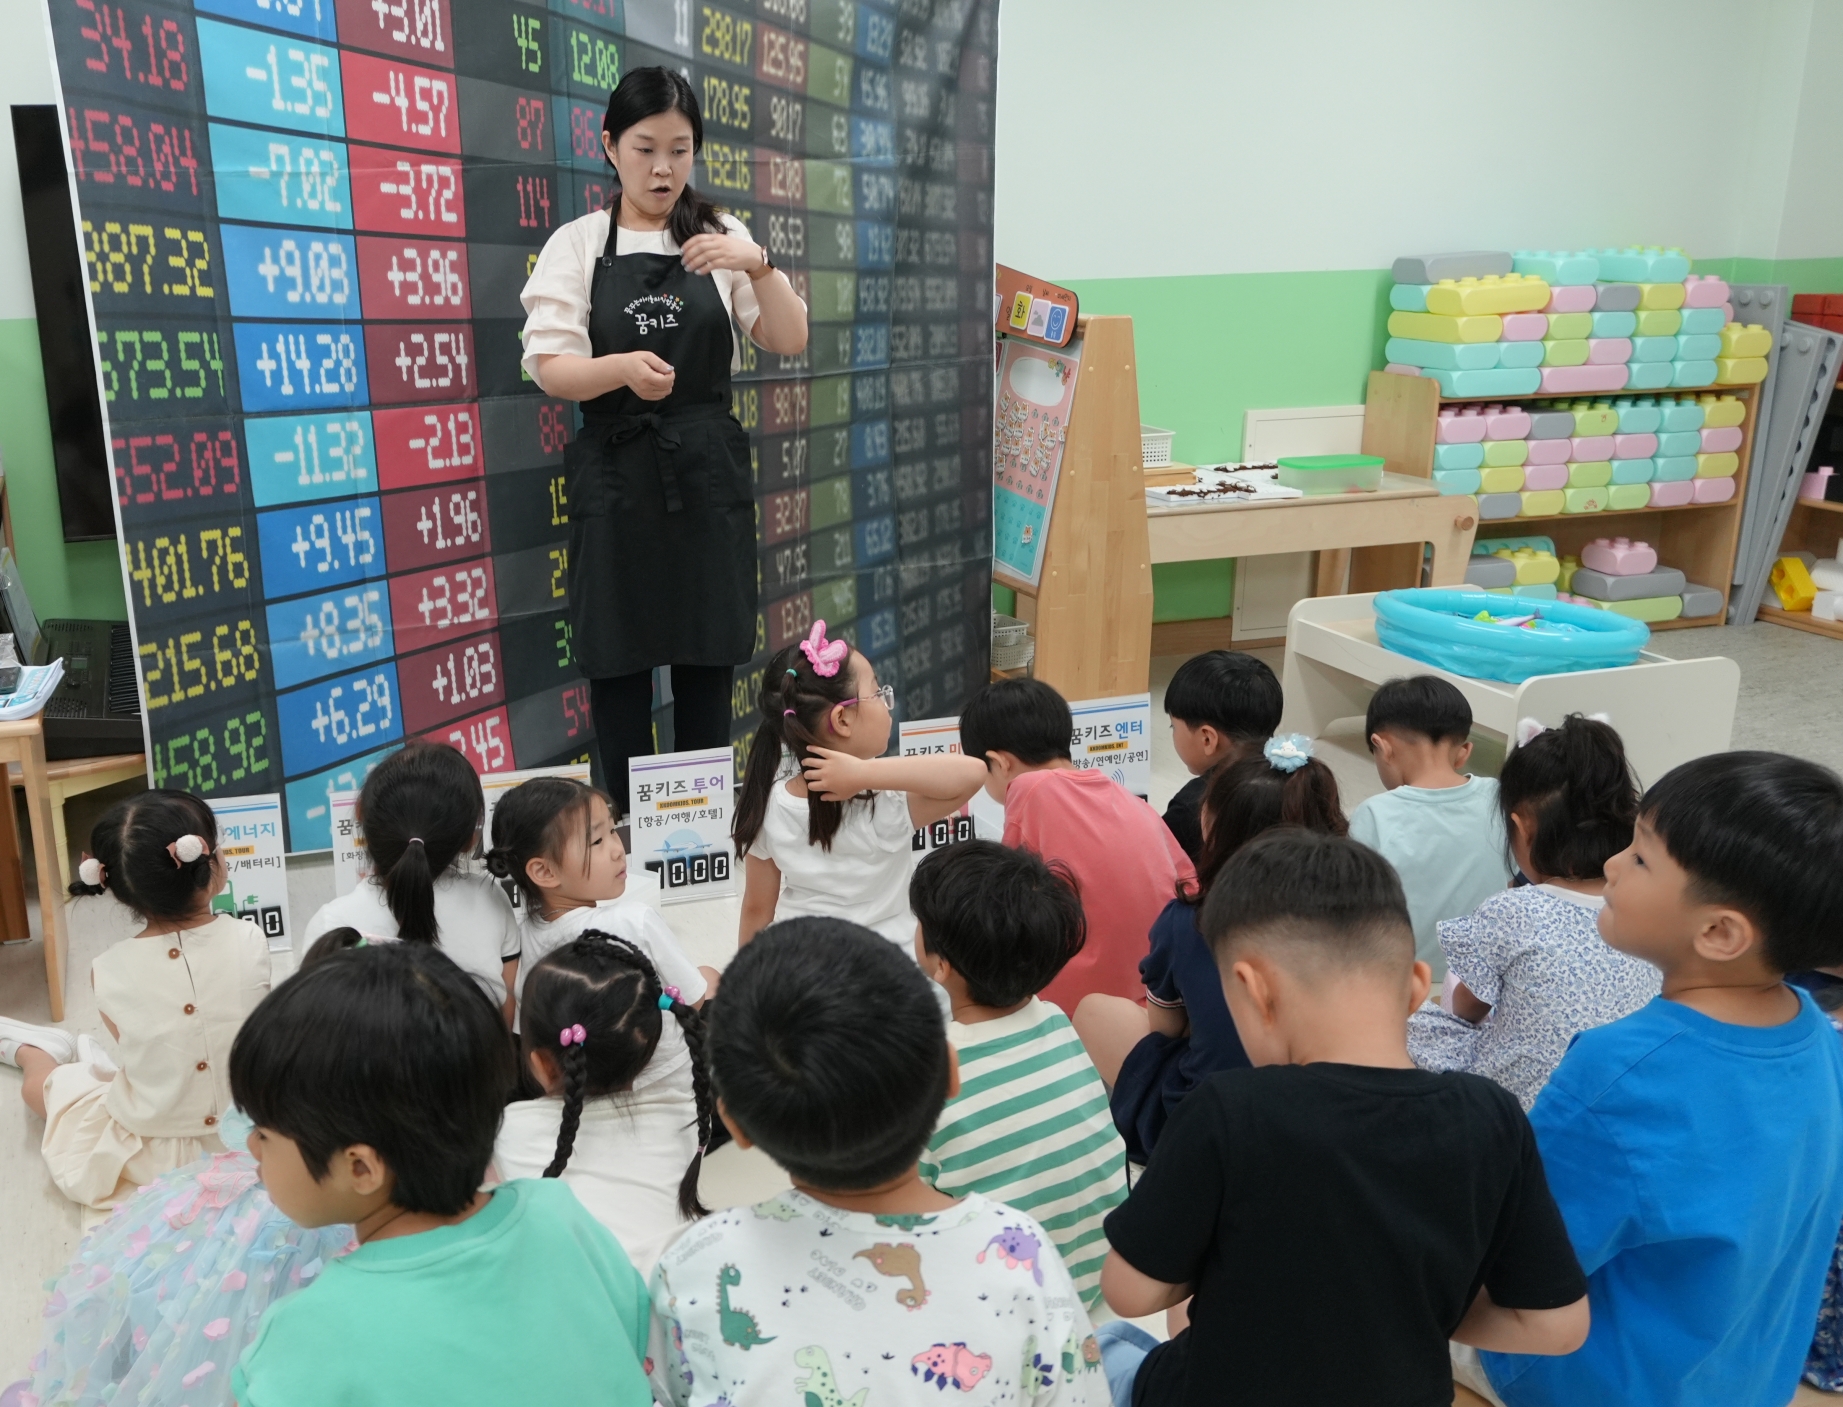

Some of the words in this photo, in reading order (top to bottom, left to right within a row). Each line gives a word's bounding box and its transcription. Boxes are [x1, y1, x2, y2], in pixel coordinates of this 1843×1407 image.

[76, 0, 187, 90] 34.18
[513, 14, 541, 73] 45
[571, 30, 619, 91] 12.08
[702, 6, 752, 66] 298.17
[762, 30, 805, 84] 125.95
[246, 45, 332, 118] -1.35
[373, 70, 448, 138] -4.57
[703, 75, 750, 130] 178.95
[516, 97, 544, 150] 87
[571, 106, 606, 160] 86.
[249, 143, 341, 212] -7.02
[380, 161, 457, 222] -3.72
[516, 175, 550, 228] 114
[258, 239, 349, 303] +9.03
[387, 248, 462, 305] +3.96
[635, 313, 678, 335] 꿈키즈
[256, 333, 357, 395] +14.28
[395, 332, 467, 388] +2.54
[274, 421, 367, 485] -11.32
[409, 412, 474, 469] -2.13
[539, 404, 568, 453] 86
[292, 507, 374, 572] +9.45
[416, 491, 481, 549] +1.96
[125, 526, 249, 607] 401.76
[301, 591, 382, 659] +8.35
[418, 567, 489, 629] +3.32
[139, 619, 259, 710] 215.68
[432, 642, 496, 704] +1.03
[311, 674, 392, 744] +6.29
[562, 685, 589, 737] 54
[1071, 724, 1112, 745] 꿈키즈
[1115, 720, 1142, 740] 엔터
[636, 780, 688, 802] 꿈키즈
[691, 775, 724, 794] 투어
[638, 808, 723, 828] [항공/여행/호텔]
[224, 822, 276, 840] 에너지
